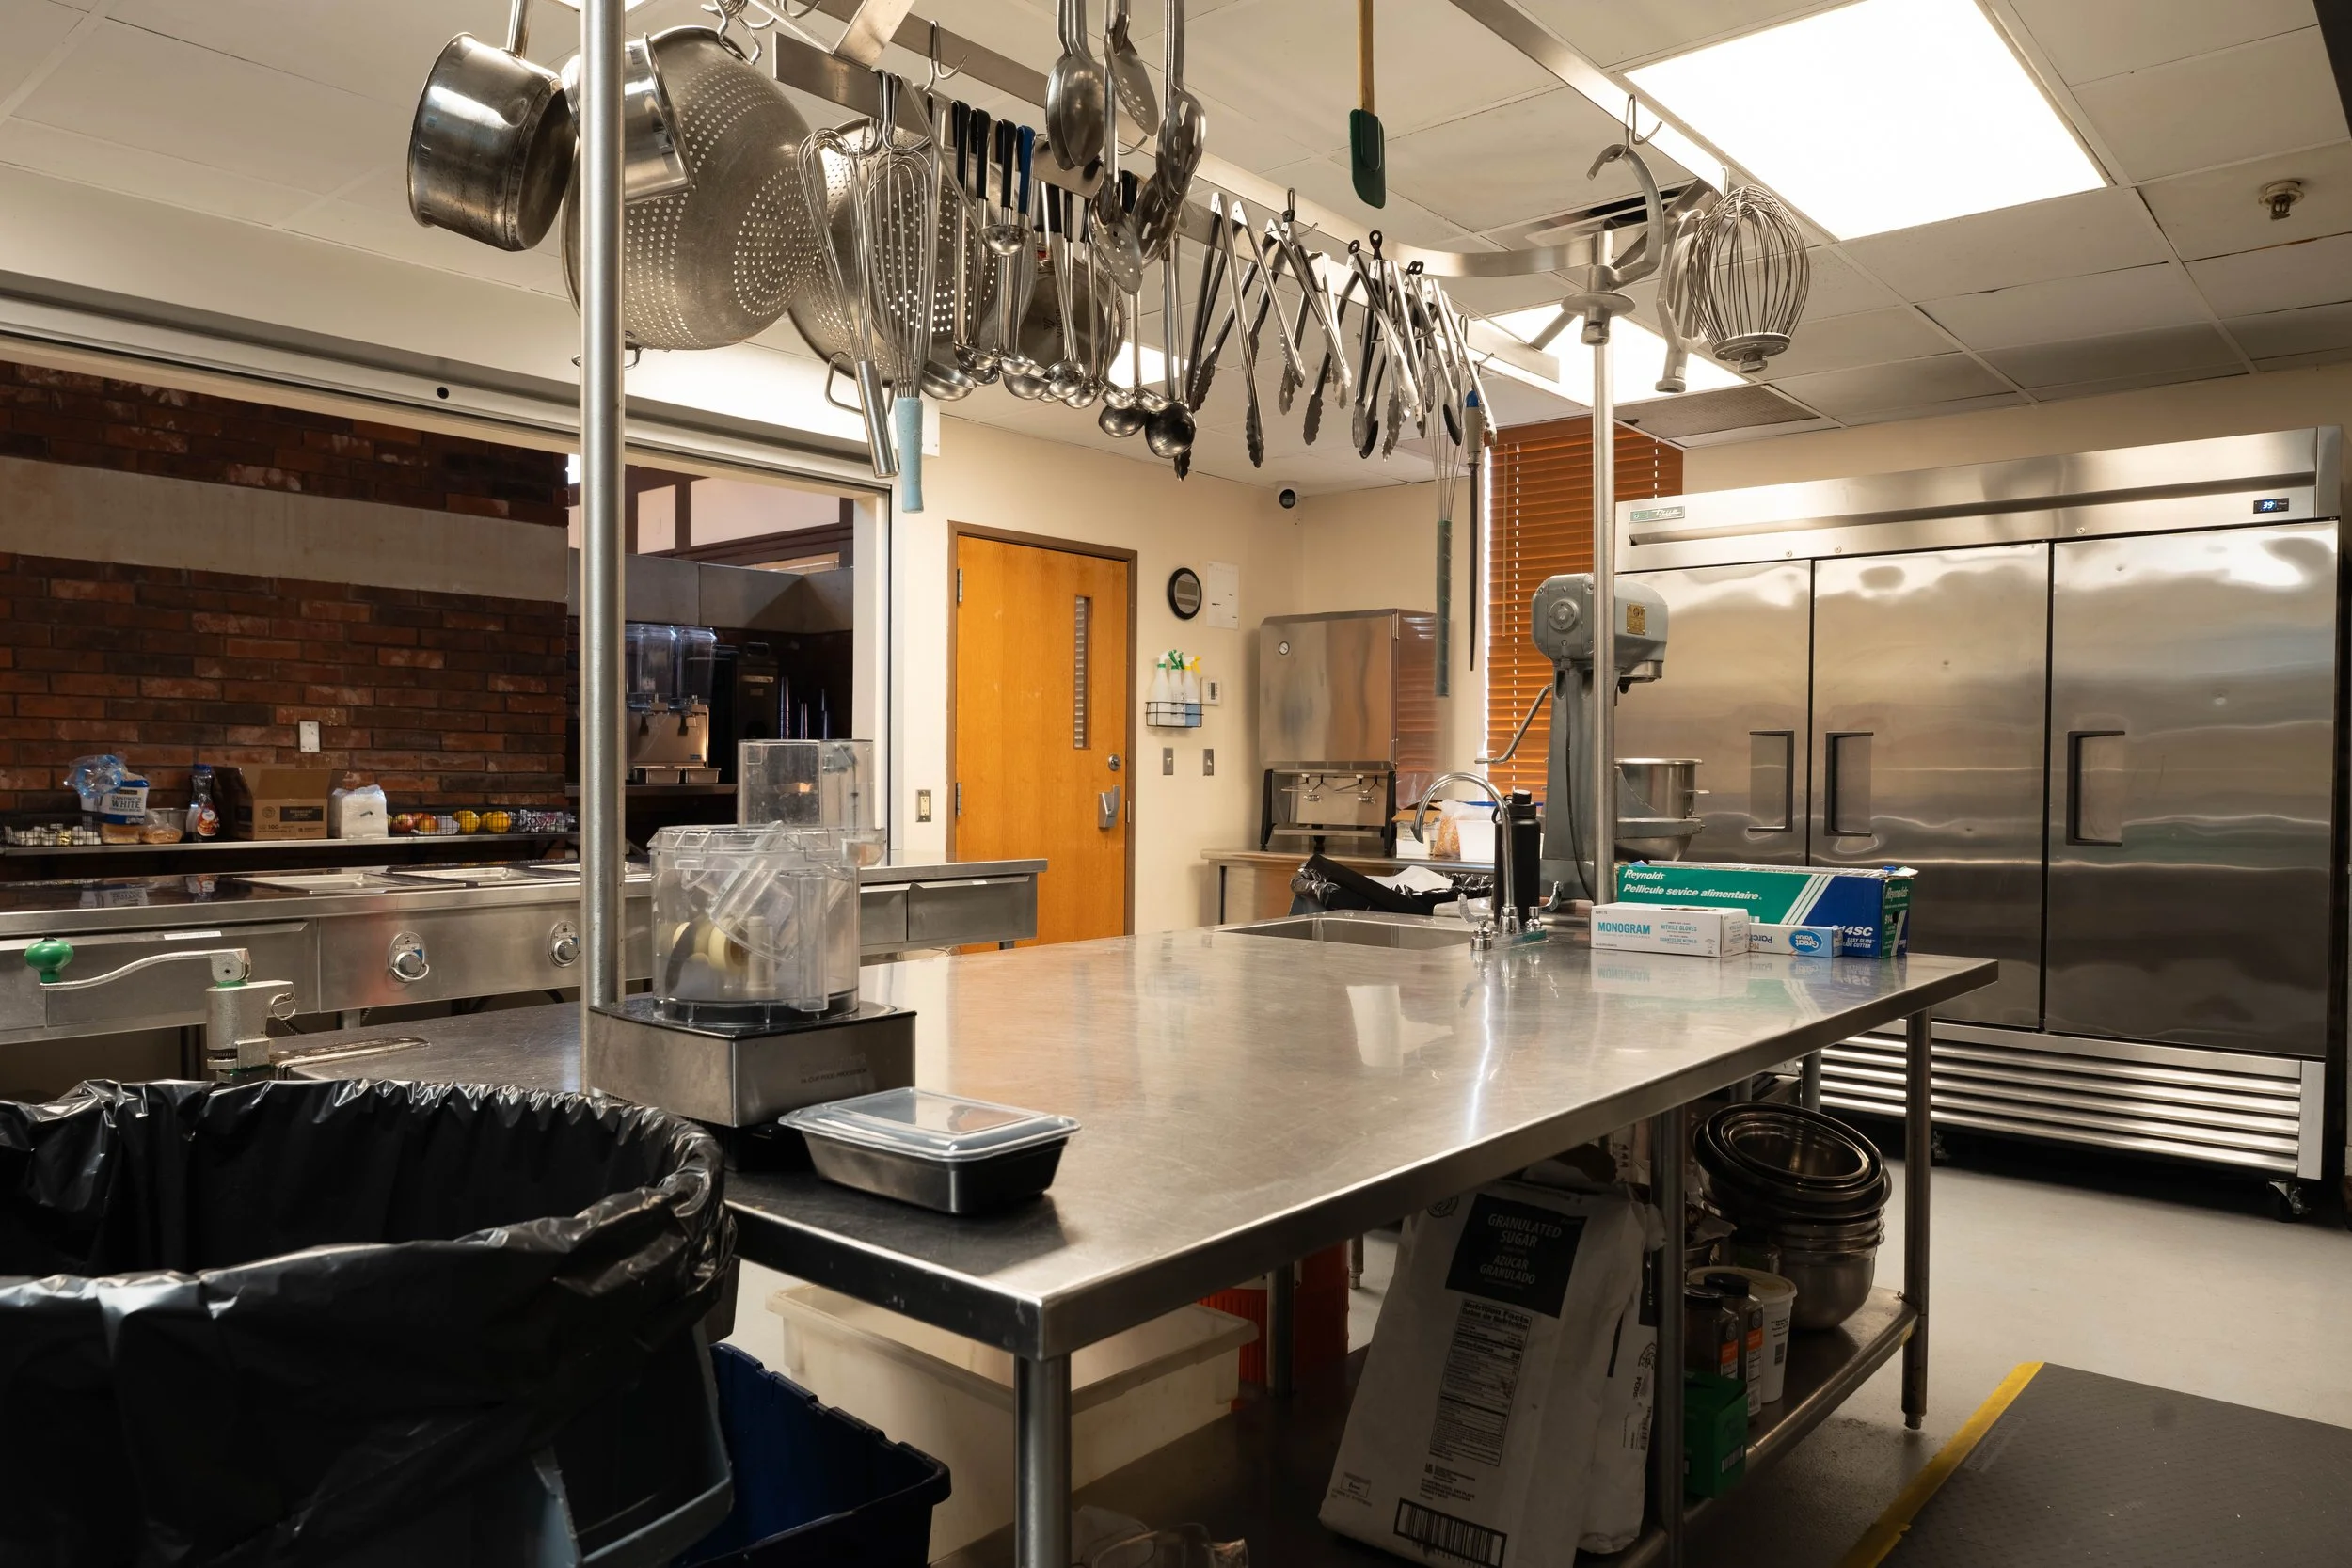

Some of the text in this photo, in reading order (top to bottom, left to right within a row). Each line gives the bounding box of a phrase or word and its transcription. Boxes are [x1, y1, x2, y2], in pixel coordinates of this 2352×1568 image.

[1624, 868, 1665, 881] Reynolds
[1623, 883, 1664, 895] Pellicule
[1666, 887, 1699, 897] sevice
[1597, 921, 1651, 935] MONOGRAM
[1795, 939, 1820, 949] Great
[1487, 1213, 1562, 1238] GRANULATED
[1499, 1230, 1538, 1248] SUGAR
[1479, 1264, 1536, 1285] GRANULADO
